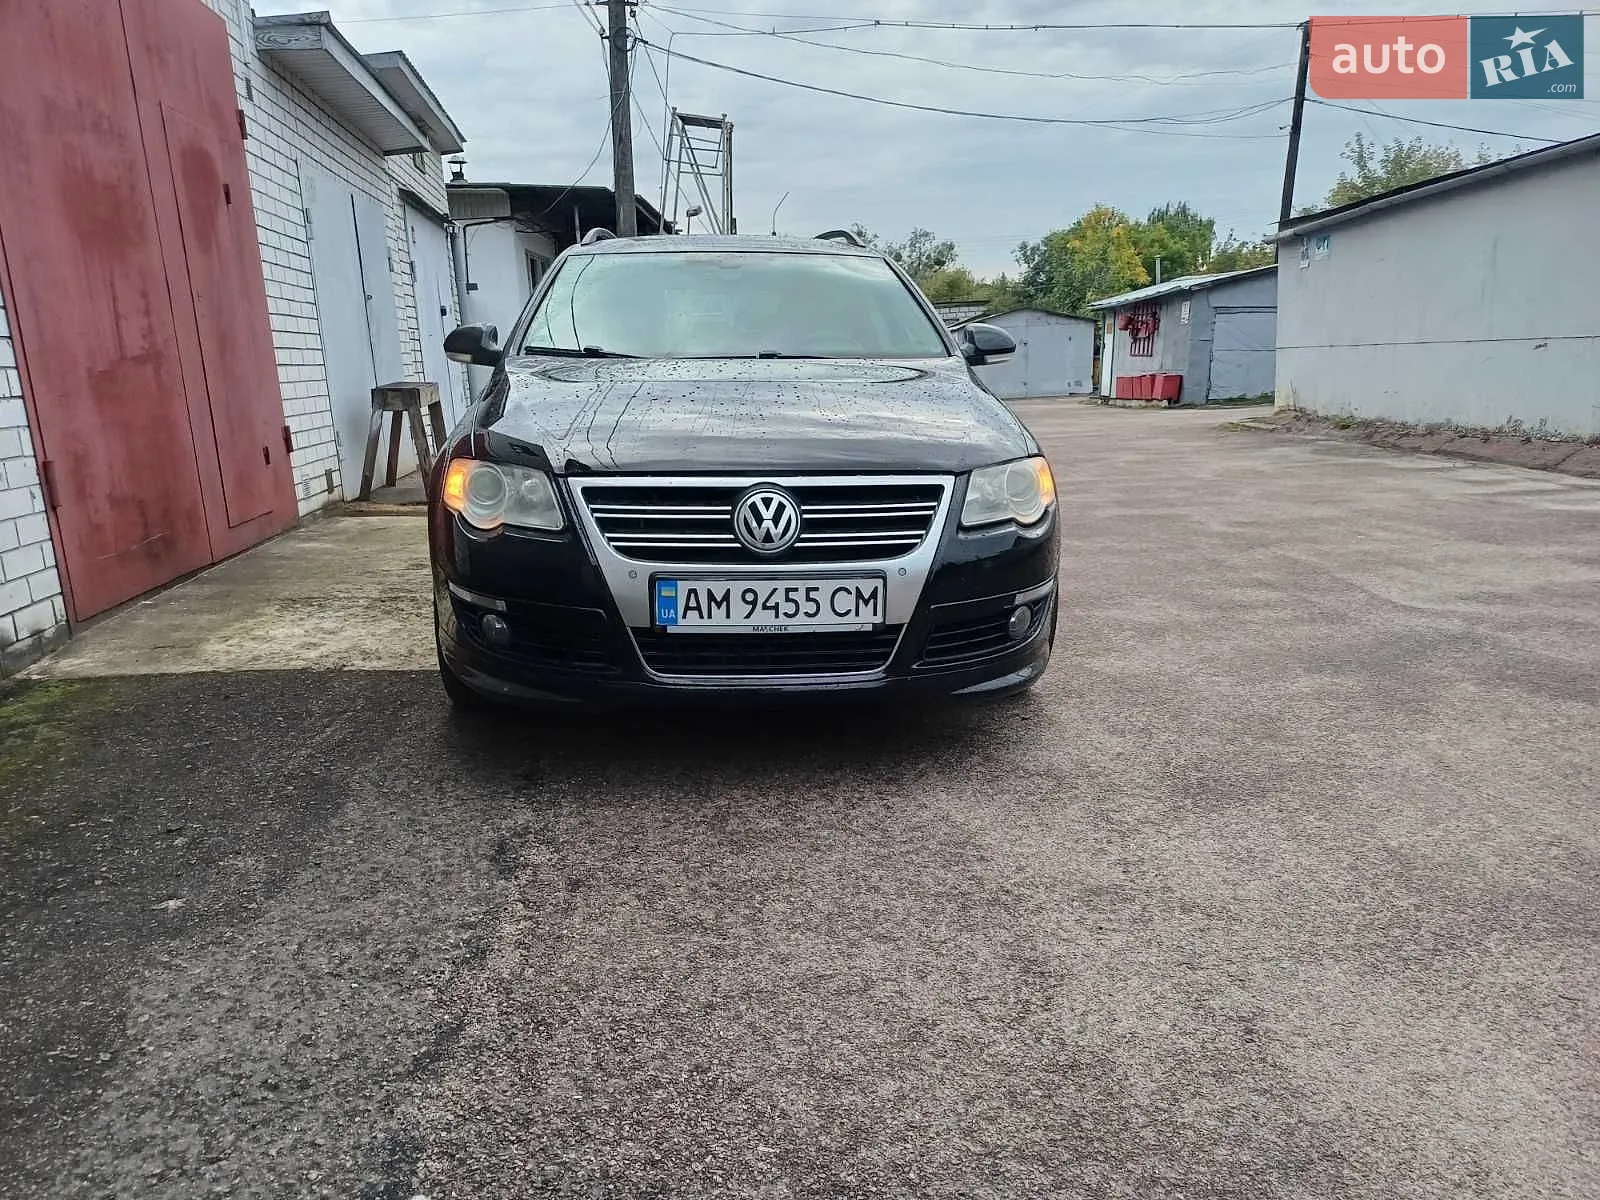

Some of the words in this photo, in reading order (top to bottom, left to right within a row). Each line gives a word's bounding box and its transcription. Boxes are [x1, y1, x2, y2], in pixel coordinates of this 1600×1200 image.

[740, 494, 796, 547] VW
[661, 609, 676, 619] UA
[682, 587, 731, 619] AM
[741, 586, 821, 619] 9455
[830, 586, 879, 617] CM
